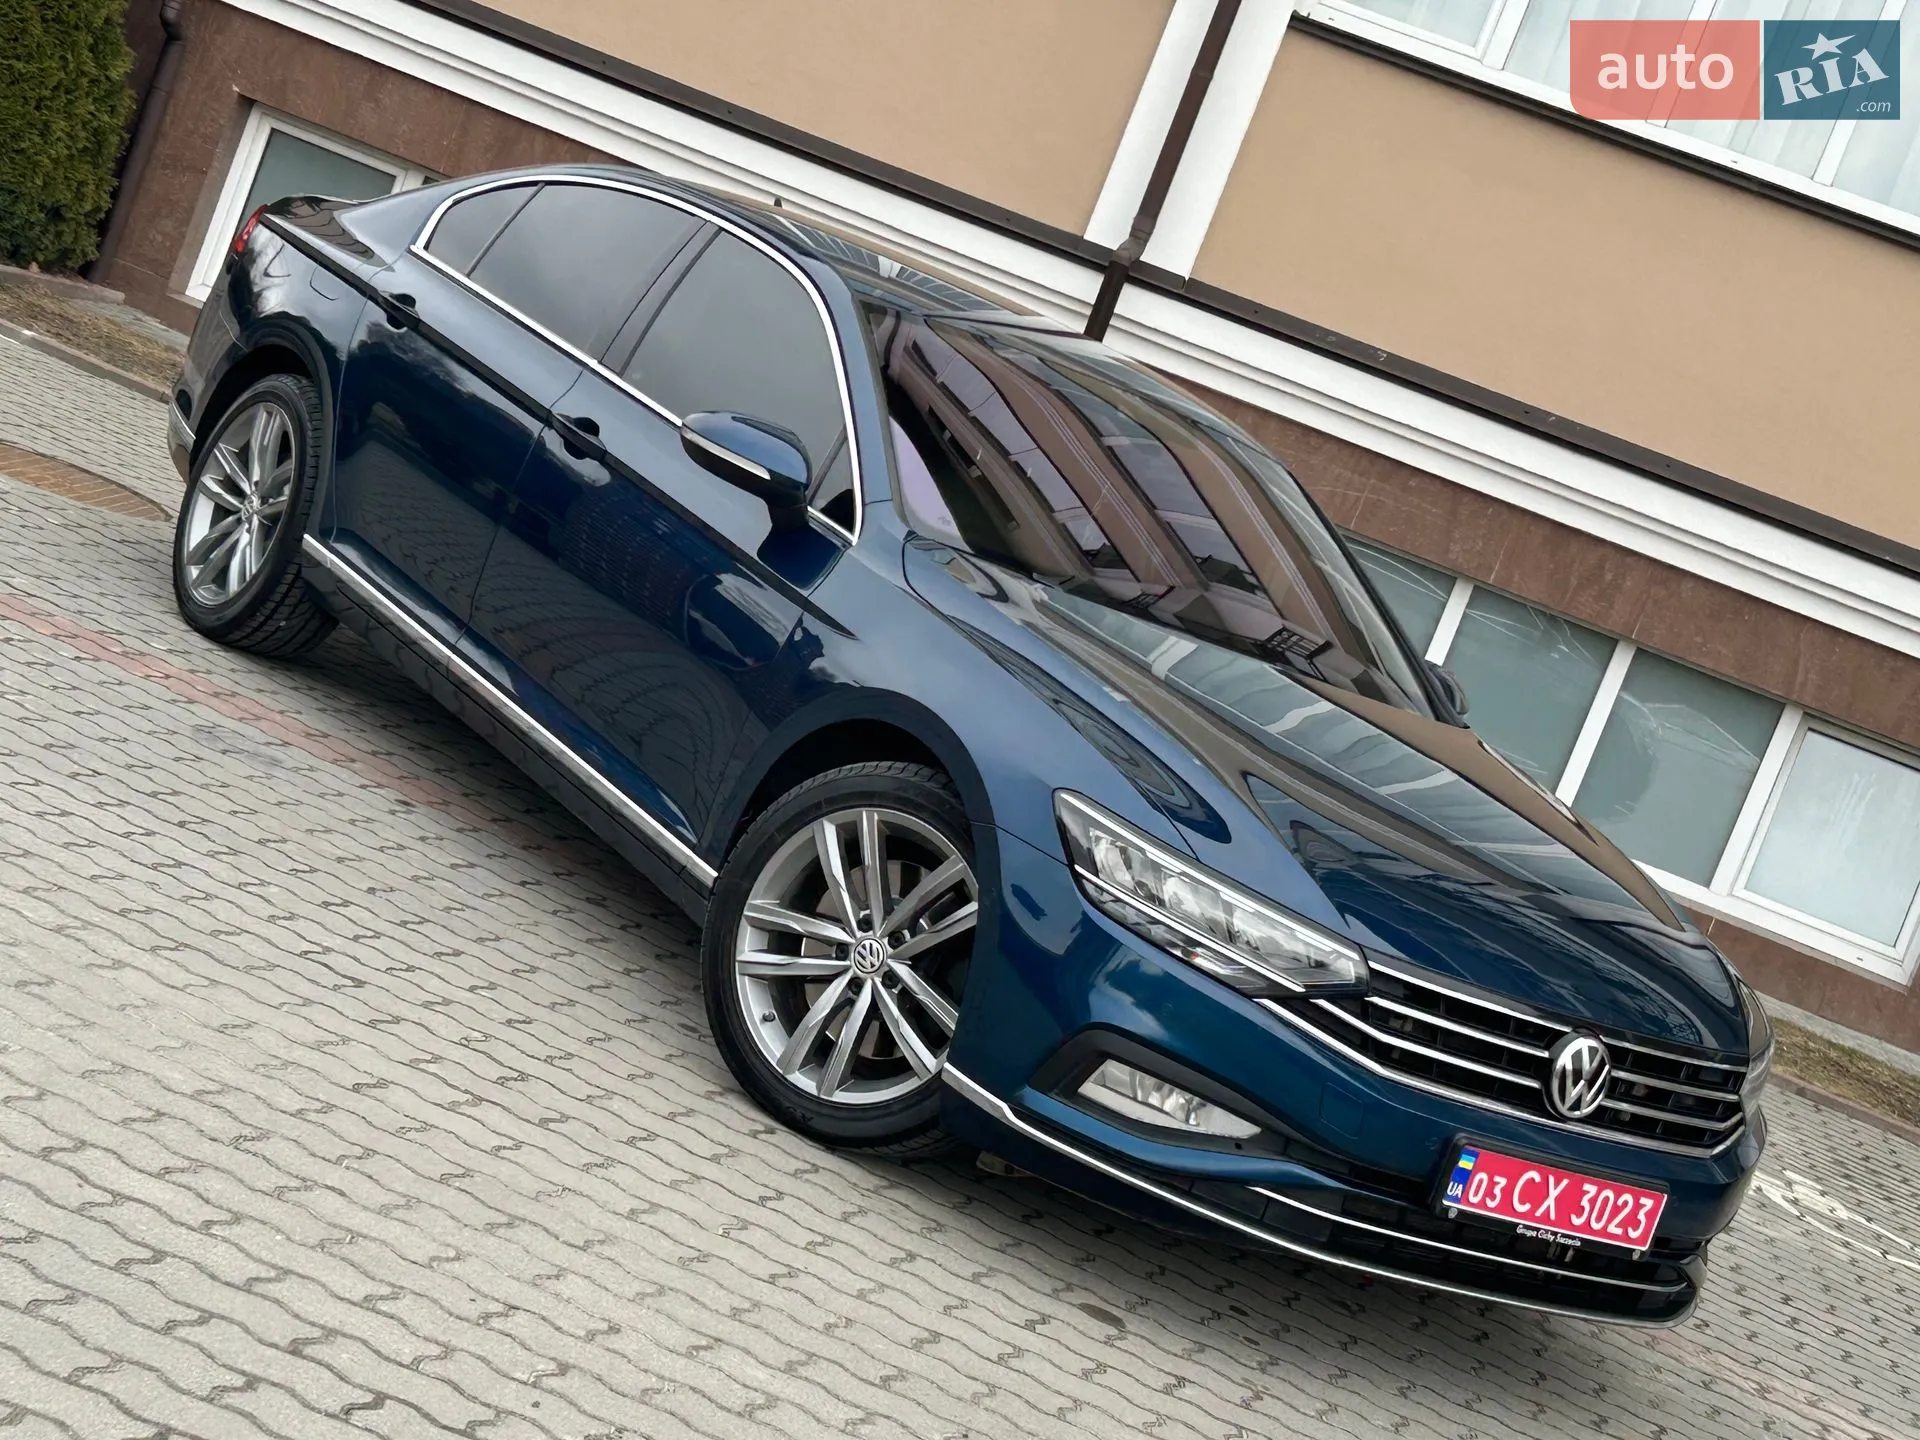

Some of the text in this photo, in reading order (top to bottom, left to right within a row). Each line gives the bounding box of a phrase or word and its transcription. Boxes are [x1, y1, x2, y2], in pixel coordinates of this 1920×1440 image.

[1446, 1181, 1464, 1198] UA
[1468, 1170, 1654, 1239] 03 CX 3023
